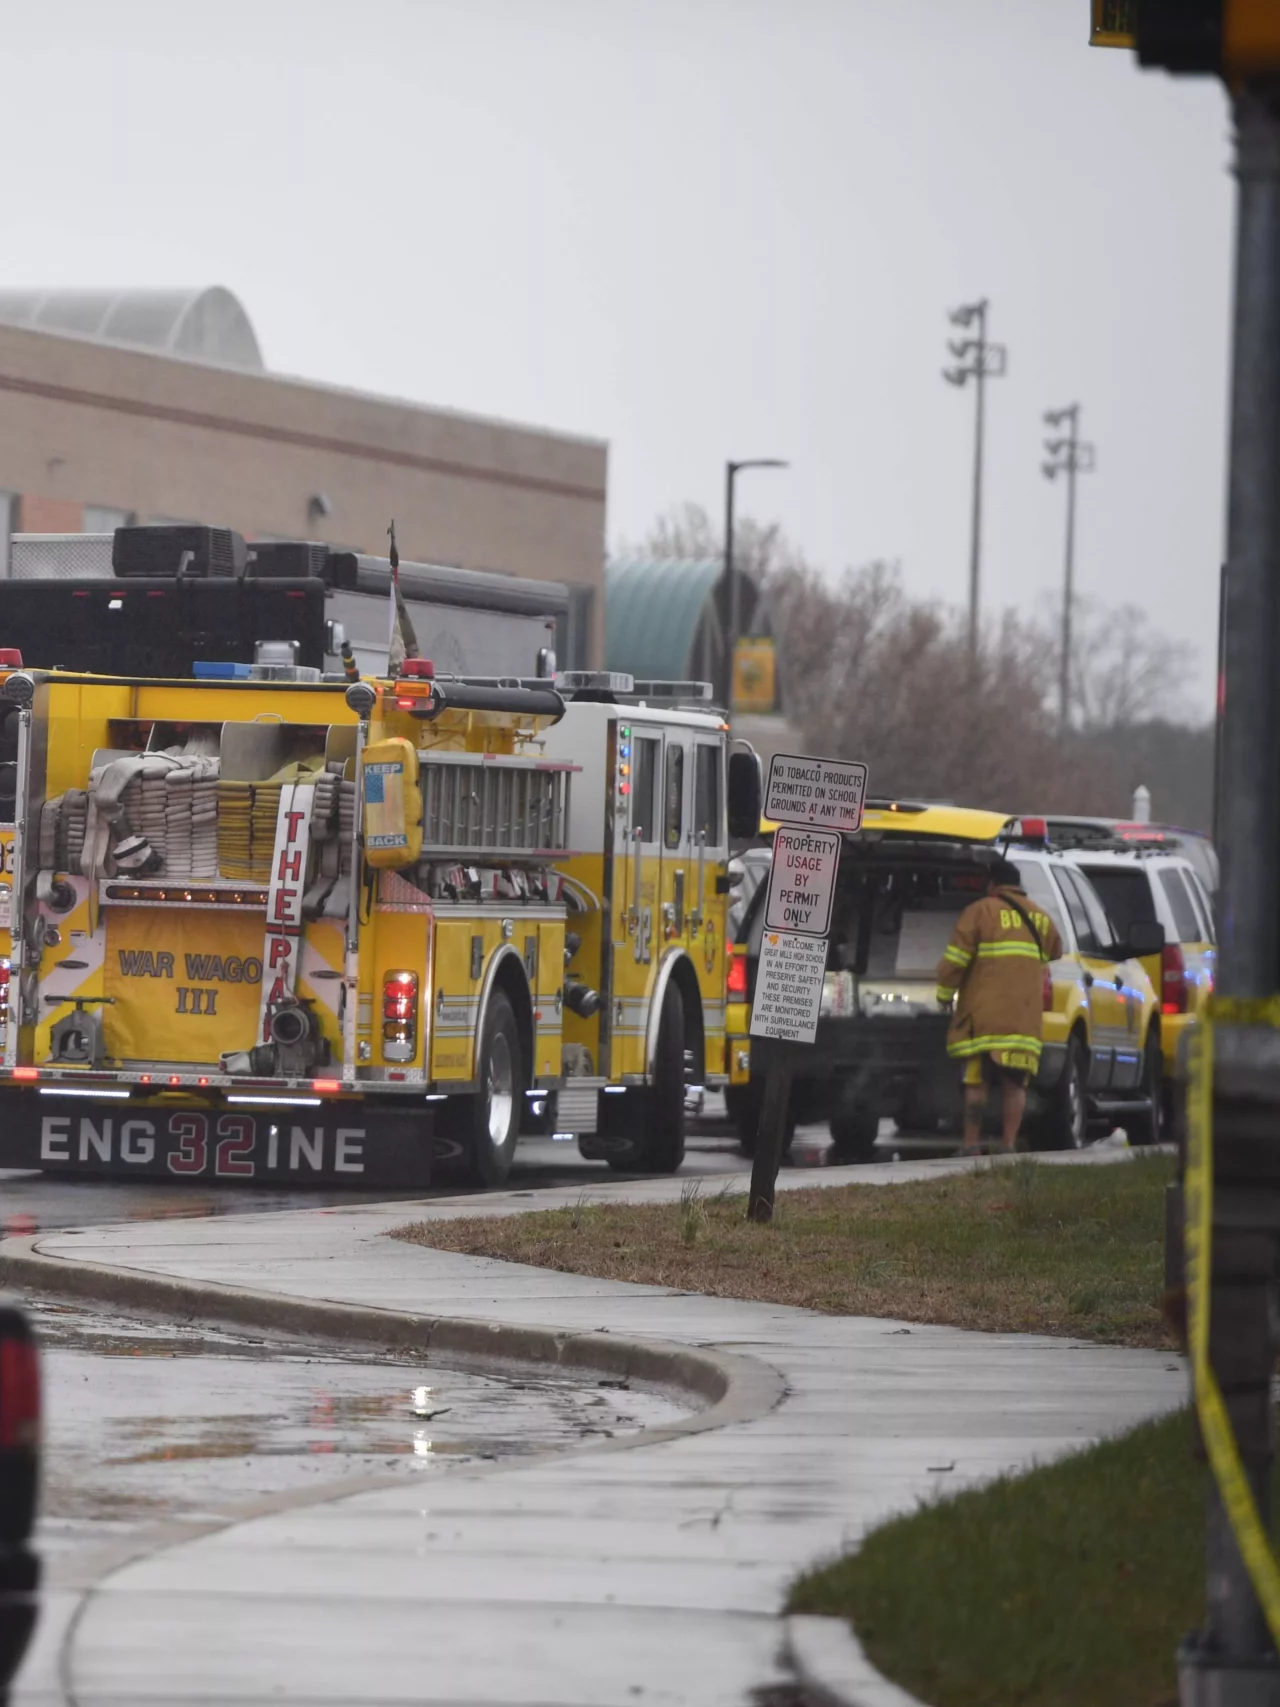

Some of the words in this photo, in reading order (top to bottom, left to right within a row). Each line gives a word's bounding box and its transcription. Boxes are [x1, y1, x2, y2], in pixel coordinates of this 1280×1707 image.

[365, 764, 400, 774] KEEP
[773, 765, 784, 777] NO
[787, 767, 820, 782] TOBACCO
[823, 772, 862, 787] PRODUCTS
[772, 782, 812, 797] PERMITTED
[815, 787, 826, 799] ON
[828, 789, 858, 803] SCHOOL
[770, 798, 806, 813] GROUNDS
[809, 803, 818, 814] AT
[820, 804, 837, 817] ANY
[840, 807, 856, 819] TIME
[367, 835, 406, 846] BACK
[779, 836, 835, 855] PROPERTY
[274, 812, 304, 920] THE
[787, 855, 822, 871] USAGE
[794, 874, 809, 887] BY
[780, 890, 820, 906] PERMIT
[783, 908, 811, 923] ONLY
[782, 939, 814, 951] WELCOME
[817, 944, 825, 953] TO
[764, 948, 778, 957] GREAT
[780, 950, 792, 960] MILLS
[793, 952, 804, 961] HIGH
[806, 954, 824, 964] SCHOOL
[119, 949, 174, 978] WAR
[185, 953, 263, 984] WAGO
[766, 960, 773, 968] IN
[775, 960, 783, 969] AN
[784, 962, 808, 973] EFFORT
[810, 965, 818, 974] TO
[766, 971, 796, 982] PRESERVE
[798, 975, 821, 985] SAFETY
[263, 939, 292, 1042] PA
[767, 982, 779, 991] AND
[781, 984, 810, 995] SECURITY
[176, 987, 218, 1015] III
[762, 992, 780, 1002] THESE
[783, 996, 813, 1007] PREMISES
[761, 1004, 772, 1013] ARE
[775, 1006, 811, 1018] MONITORED
[755, 1014, 769, 1023] WITH
[770, 1016, 815, 1030] SURVEILLANCE
[765, 1027, 800, 1039] EQUIPMENT
[40, 1116, 155, 1163] ENG
[167, 1112, 256, 1176] 32
[268, 1125, 366, 1172] INE
